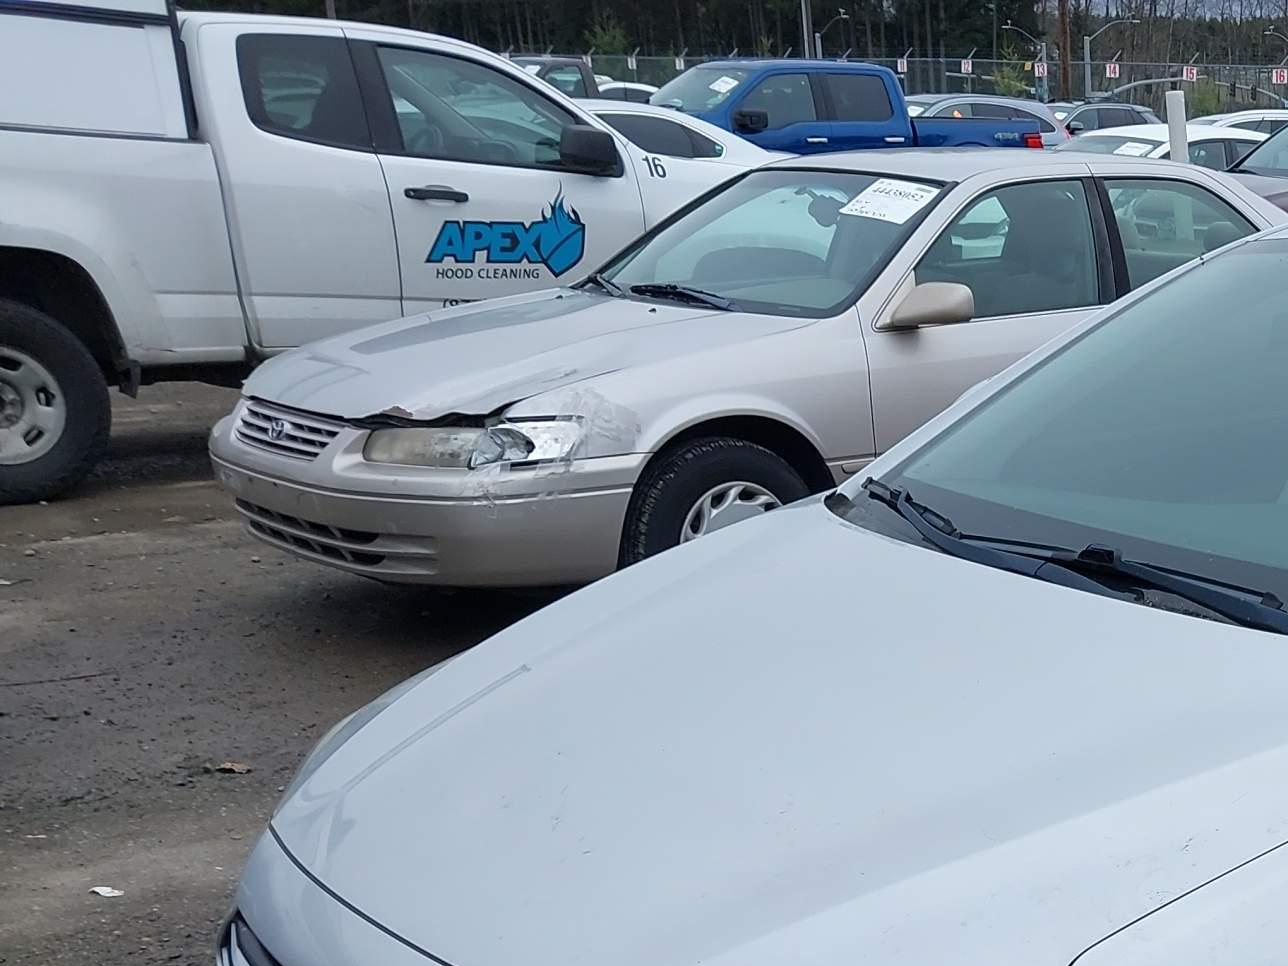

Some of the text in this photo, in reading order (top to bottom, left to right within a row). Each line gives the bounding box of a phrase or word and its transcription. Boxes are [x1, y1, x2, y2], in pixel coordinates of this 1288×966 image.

[963, 60, 971, 72] 12
[1036, 64, 1046, 76] 13
[1108, 65, 1117, 76] 14
[1185, 67, 1195, 80] 15
[1275, 70, 1286, 83] 16
[641, 155, 667, 178] 16
[425, 220, 548, 263] APEX
[436, 268, 540, 280] HOOD CLEANING
